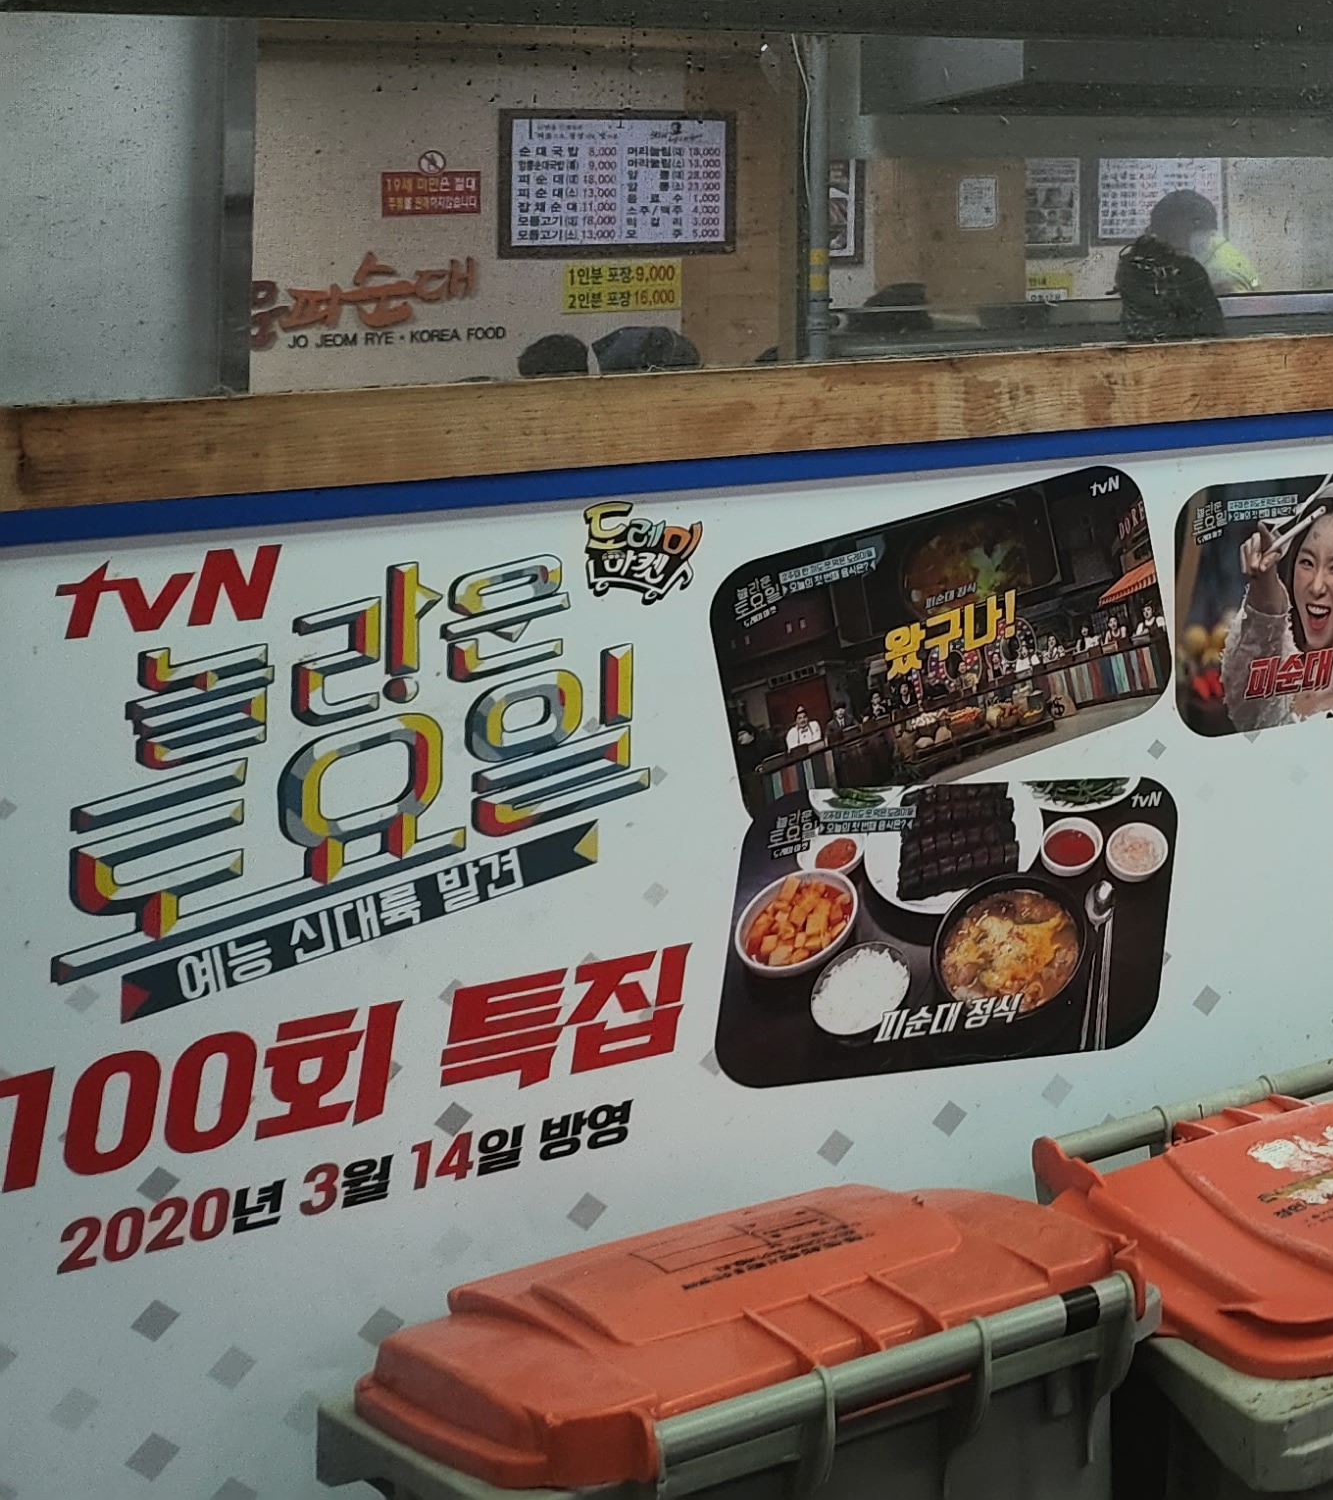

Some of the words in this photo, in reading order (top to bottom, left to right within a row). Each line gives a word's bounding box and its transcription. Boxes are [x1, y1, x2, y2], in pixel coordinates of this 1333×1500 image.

[569, 267, 603, 286] 1인분
[607, 266, 632, 283] 포장
[636, 265, 675, 283] 9,000
[569, 292, 602, 309] 2인분
[607, 290, 630, 307] 포장
[288, 335, 308, 349] JO
[315, 332, 357, 348] JEOM
[364, 331, 394, 345] RYE
[409, 328, 460, 343] KOREA
[467, 326, 506, 341] FOOD
[1090, 475, 1119, 497] tvN
[584, 501, 703, 560] 도레미
[55, 543, 284, 641] tvN
[125, 554, 572, 771] 놀라운
[885, 588, 1016, 681] 왔구나!
[50, 643, 651, 985] 토요일
[1131, 790, 1163, 808] tvN
[176, 936, 275, 1001] 예능
[289, 888, 422, 957] 신대륙
[436, 854, 524, 912] 발견
[873, 1001, 961, 1044] 피순대
[965, 992, 1024, 1034] 정식
[0, 998, 404, 1194] 100회
[439, 942, 694, 1090] 특집
[56, 1177, 286, 1276] 2020년
[299, 1154, 394, 1218] 3월
[410, 1107, 524, 1192] 14일
[539, 1098, 634, 1162] 방영
